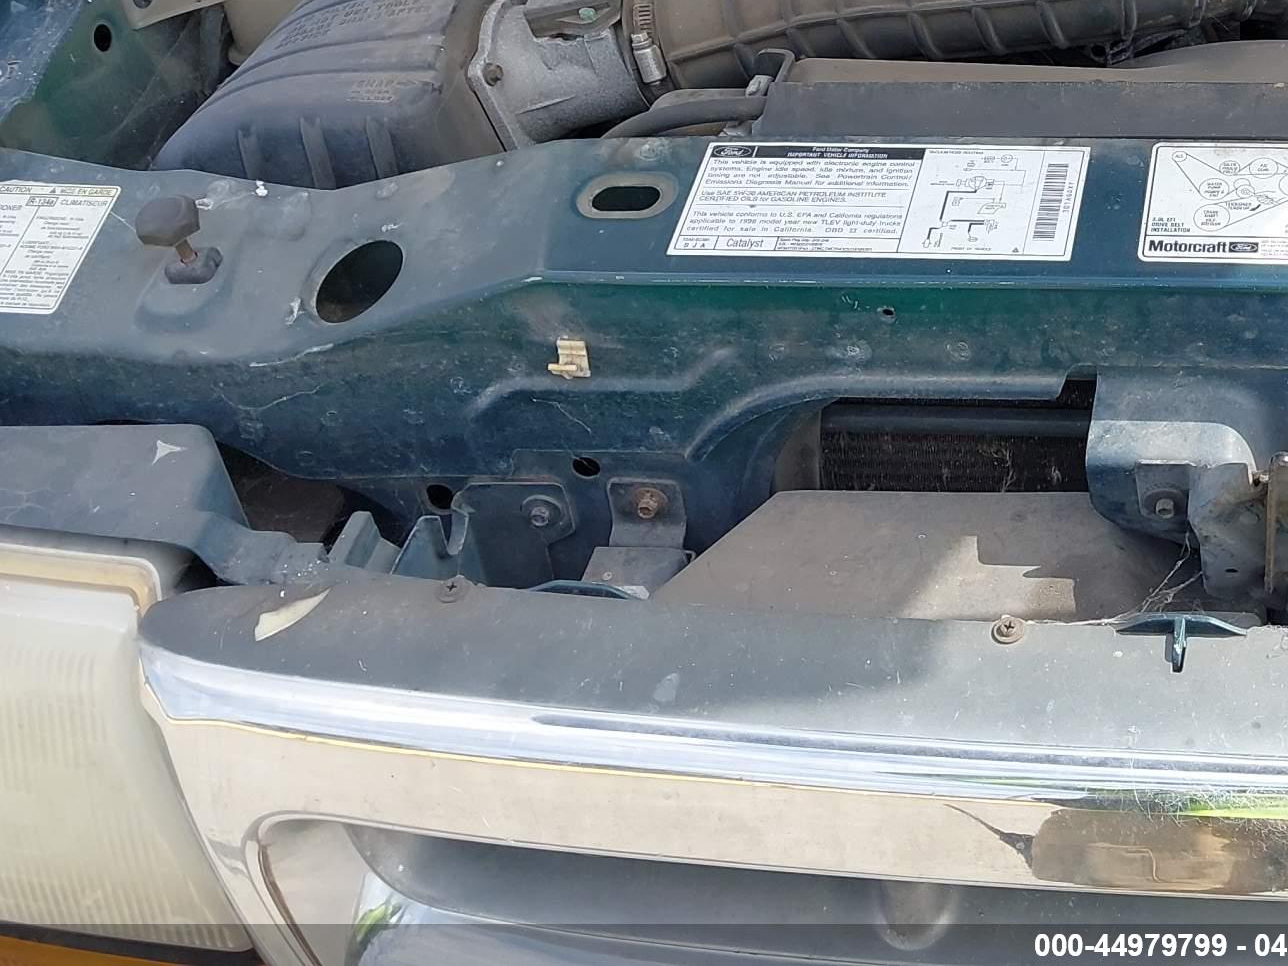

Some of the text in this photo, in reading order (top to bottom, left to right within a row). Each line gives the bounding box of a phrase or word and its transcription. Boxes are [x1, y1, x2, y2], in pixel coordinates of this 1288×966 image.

[722, 148, 742, 156] Ford
[726, 238, 764, 250] Catalyst
[1149, 240, 1227, 254] Motorcraft
